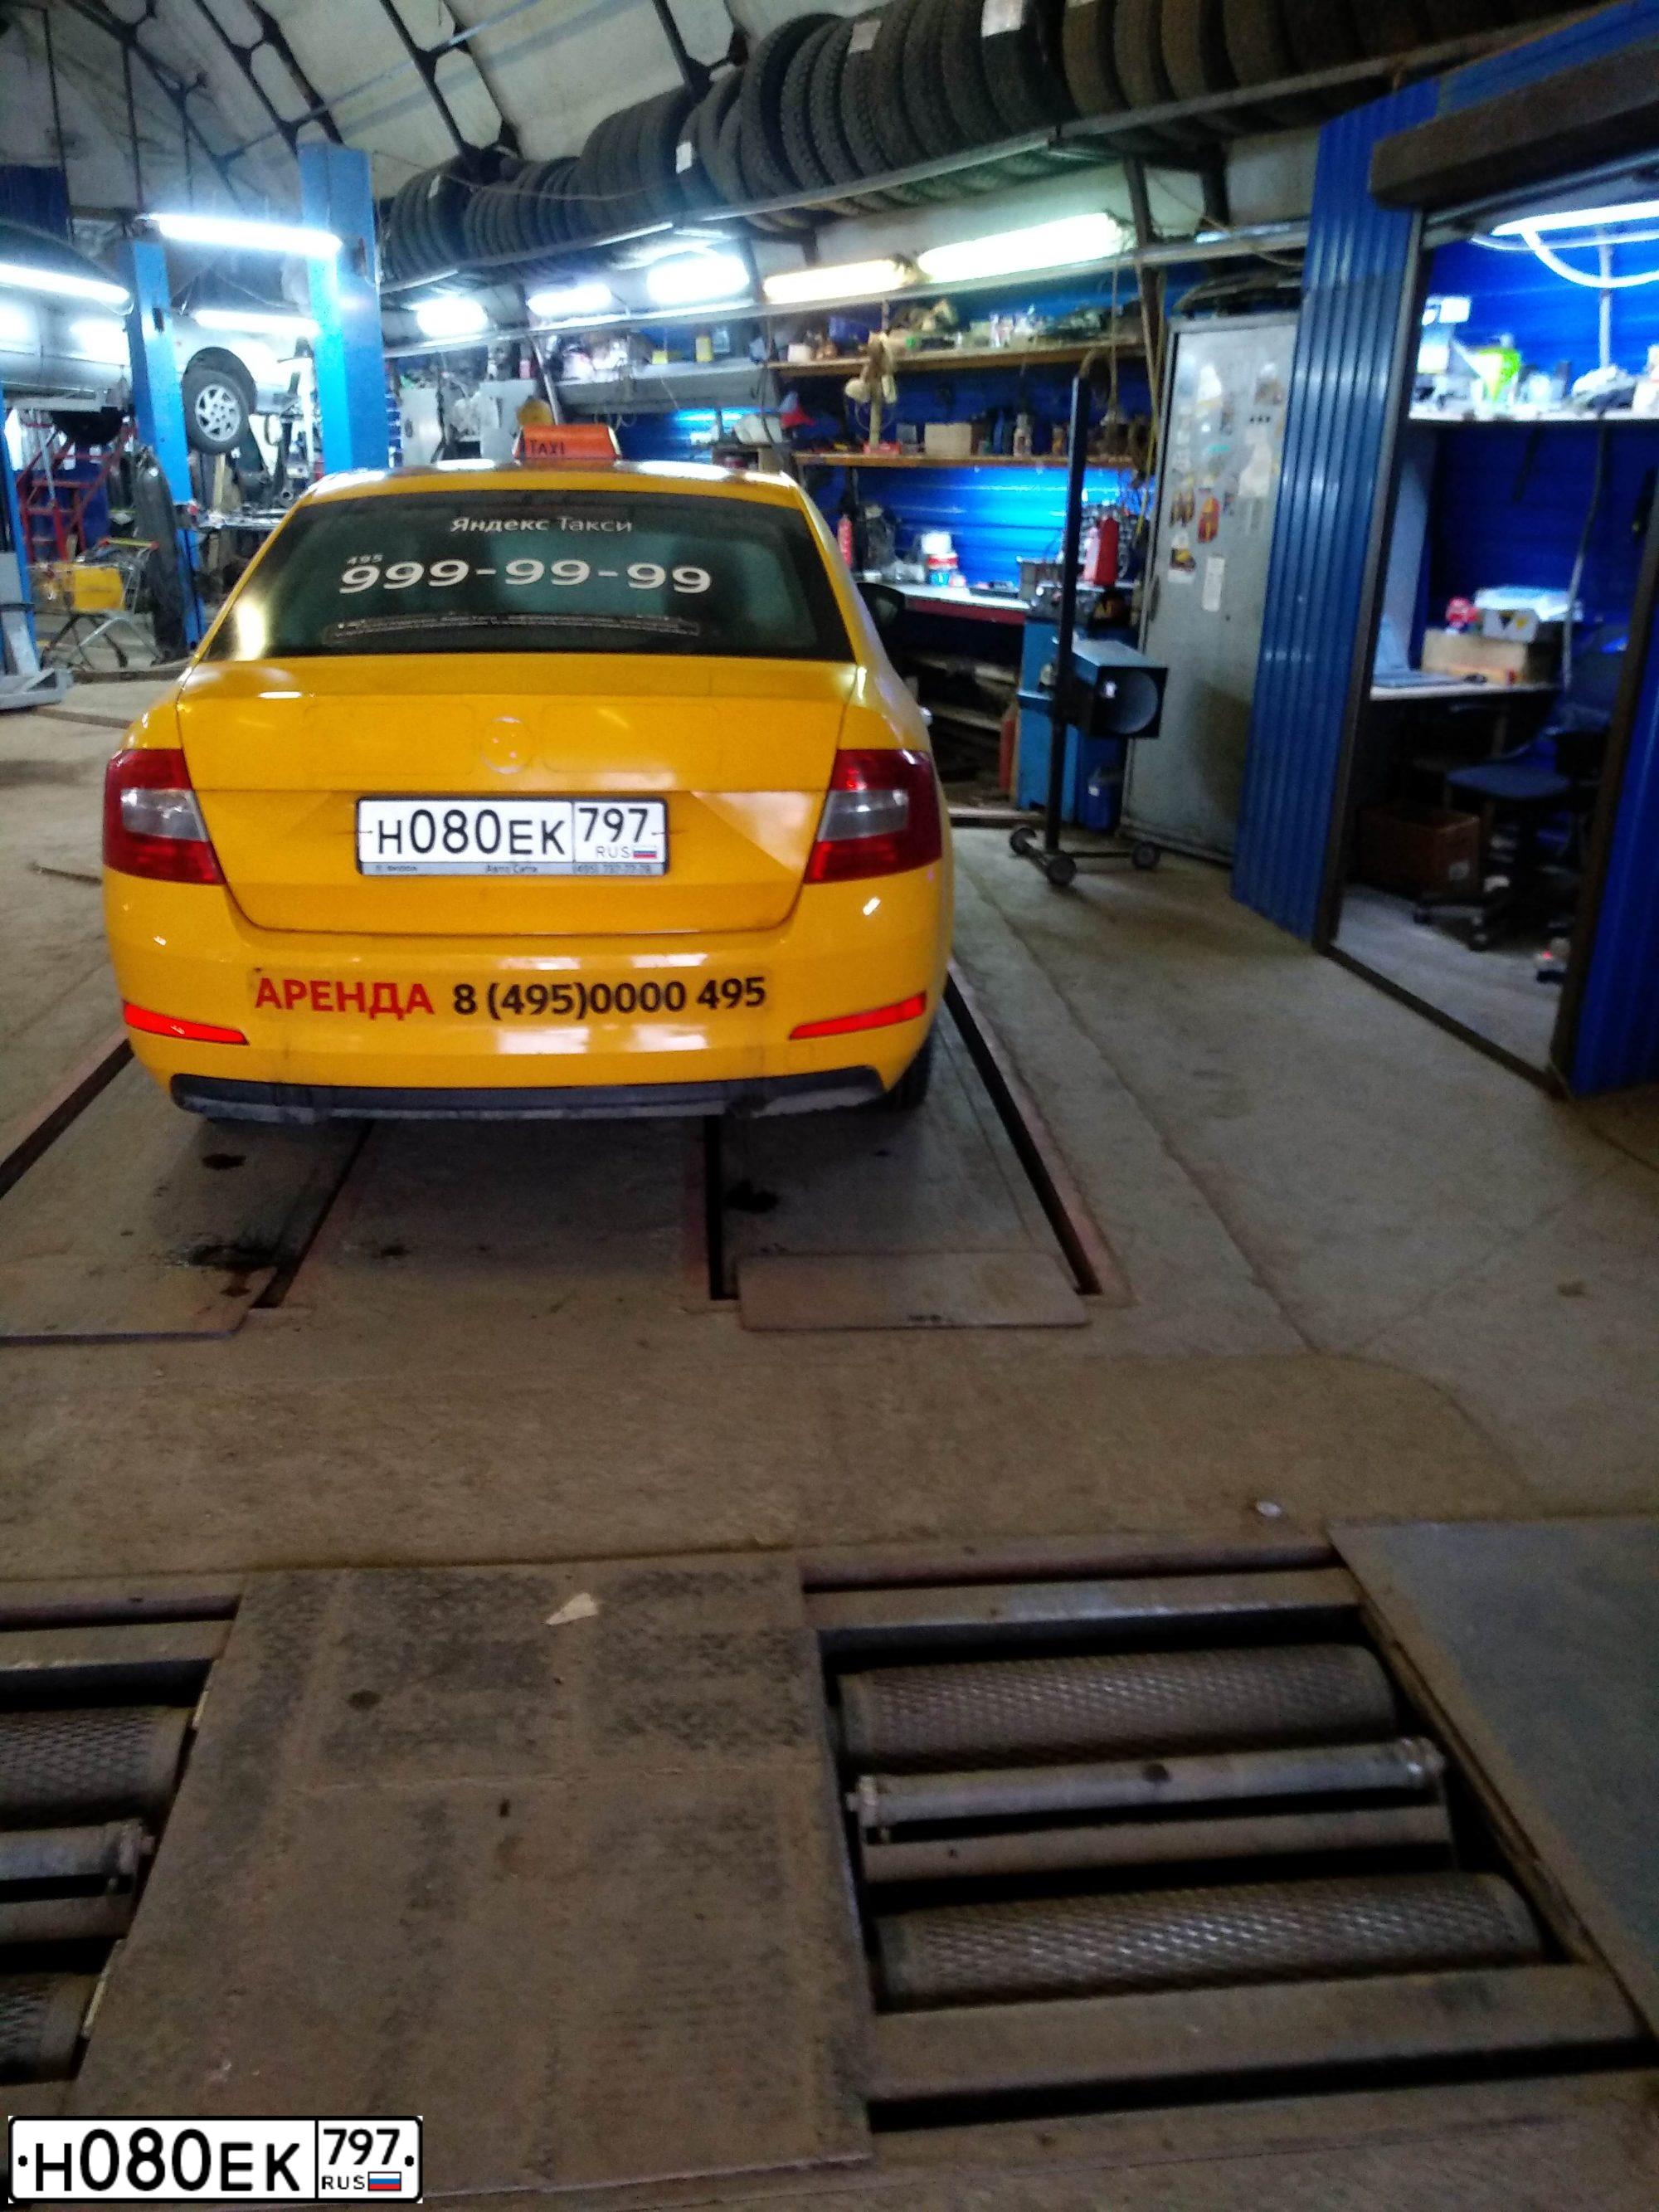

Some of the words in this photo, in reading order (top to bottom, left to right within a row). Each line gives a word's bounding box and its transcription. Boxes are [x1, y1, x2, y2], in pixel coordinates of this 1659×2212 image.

[530, 439, 564, 455] TAXI
[450, 516, 551, 533] Яндекс
[557, 516, 632, 533] Такси
[347, 553, 382, 565] 495
[339, 559, 711, 594] 999-99-99
[578, 807, 648, 843] 797
[596, 845, 630, 859] RUS
[255, 977, 435, 1021] АРЕНДА
[453, 983, 478, 1015] 8
[697, 977, 766, 1010] 495
